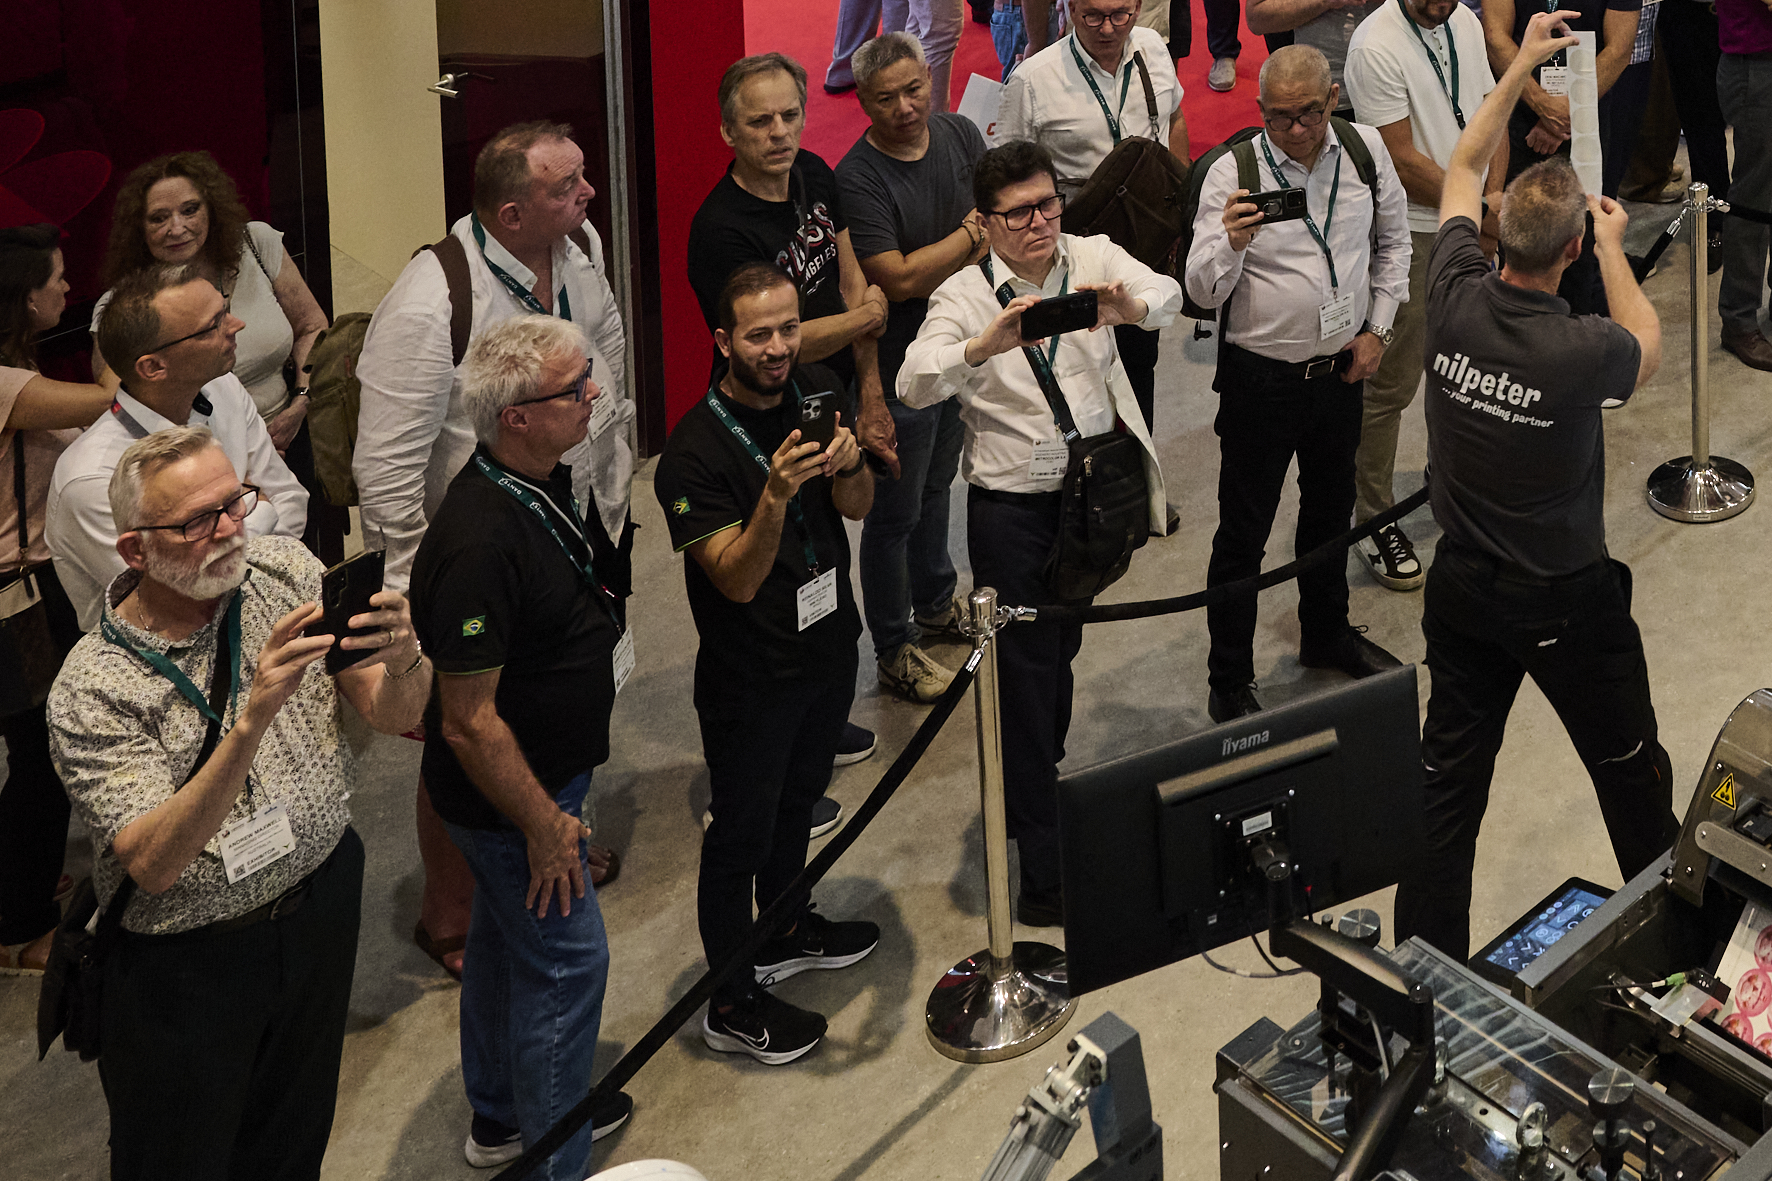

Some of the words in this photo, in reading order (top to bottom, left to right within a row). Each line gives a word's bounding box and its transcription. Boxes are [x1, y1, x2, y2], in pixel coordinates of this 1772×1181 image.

[1433, 352, 1542, 408] nilpeter
[1472, 400, 1510, 421] printing
[1512, 412, 1554, 428] partner
[1222, 730, 1270, 756] iiyama
[228, 832, 253, 850] ANDREW
[253, 818, 283, 837] MAXWELL
